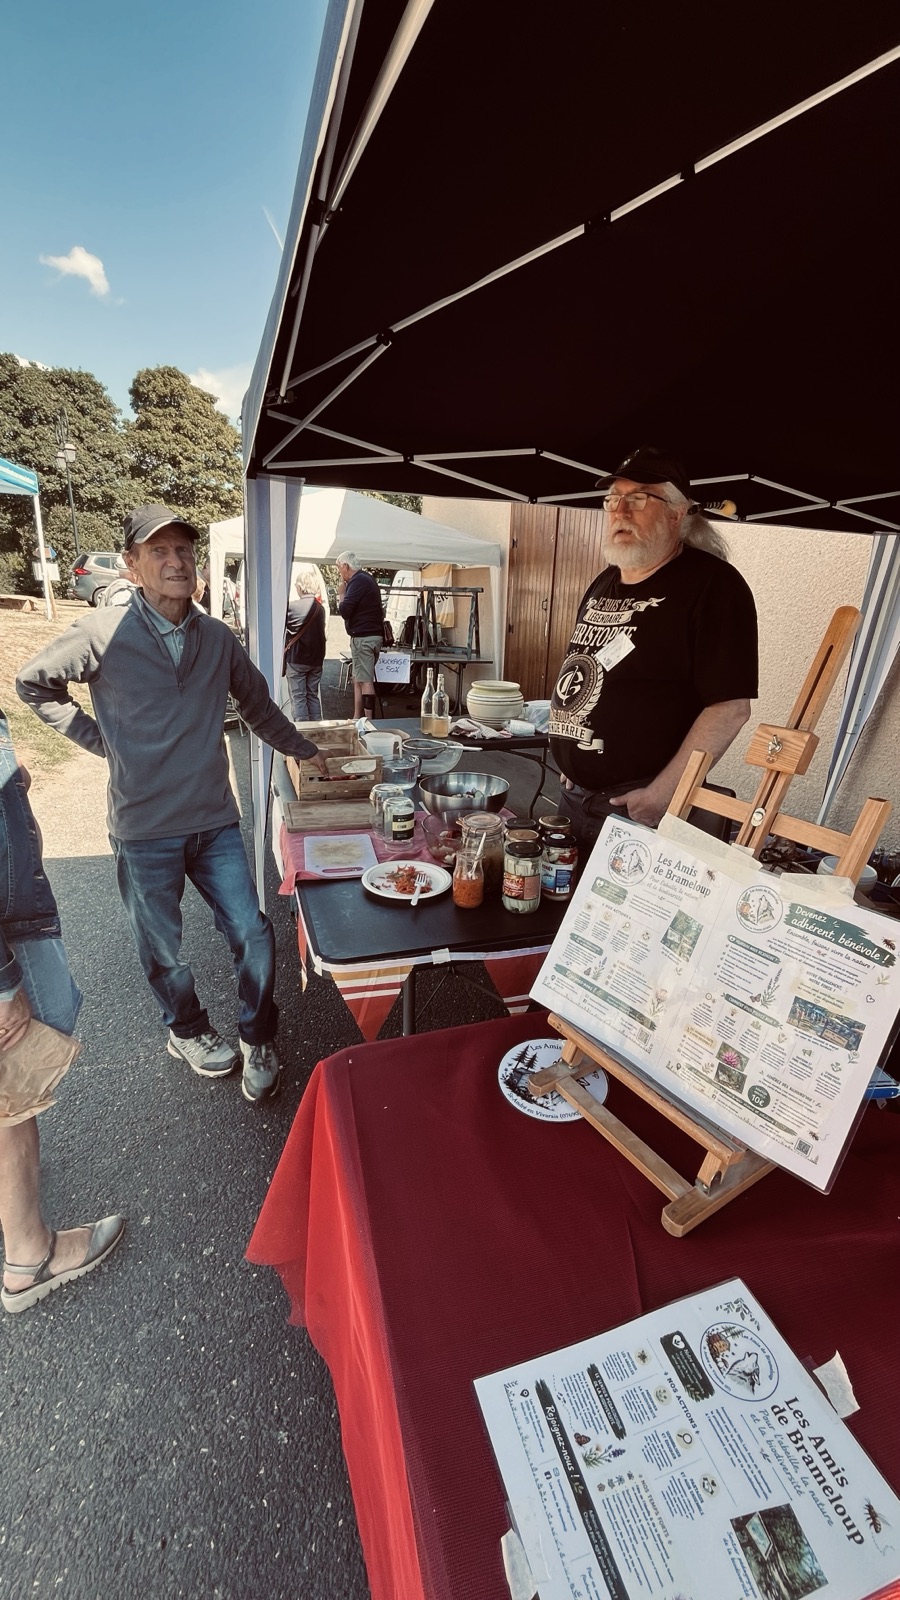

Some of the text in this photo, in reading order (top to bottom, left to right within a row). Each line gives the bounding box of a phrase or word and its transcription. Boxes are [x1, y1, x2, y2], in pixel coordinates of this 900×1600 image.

[603, 598, 621, 612] SUIS
[561, 723, 586, 740] PARLE
[652, 864, 712, 899] de Brameloup
[656, 852, 698, 878] Les Amis
[790, 913, 836, 942] adhérent,
[837, 932, 881, 961] bénévole
[794, 905, 828, 923] Devenez
[786, 928, 811, 944] Ensemble,
[810, 939, 831, 952] faisons
[830, 949, 844, 957] vivre
[851, 958, 871, 969] nature
[749, 1094, 765, 1110] 10€
[666, 1377, 679, 1394] NOS
[675, 1395, 698, 1429] ACTIONS
[545, 1404, 575, 1474] Rejoignez-nous
[750, 1413, 806, 1497] et la biodiversité
[784, 1396, 849, 1488] Les Amis
[758, 1408, 834, 1527] Pour l'abeille, la nature
[770, 1404, 865, 1545] de Brameloup
[640, 1479, 670, 1538] NOS TEMPS FORTS
